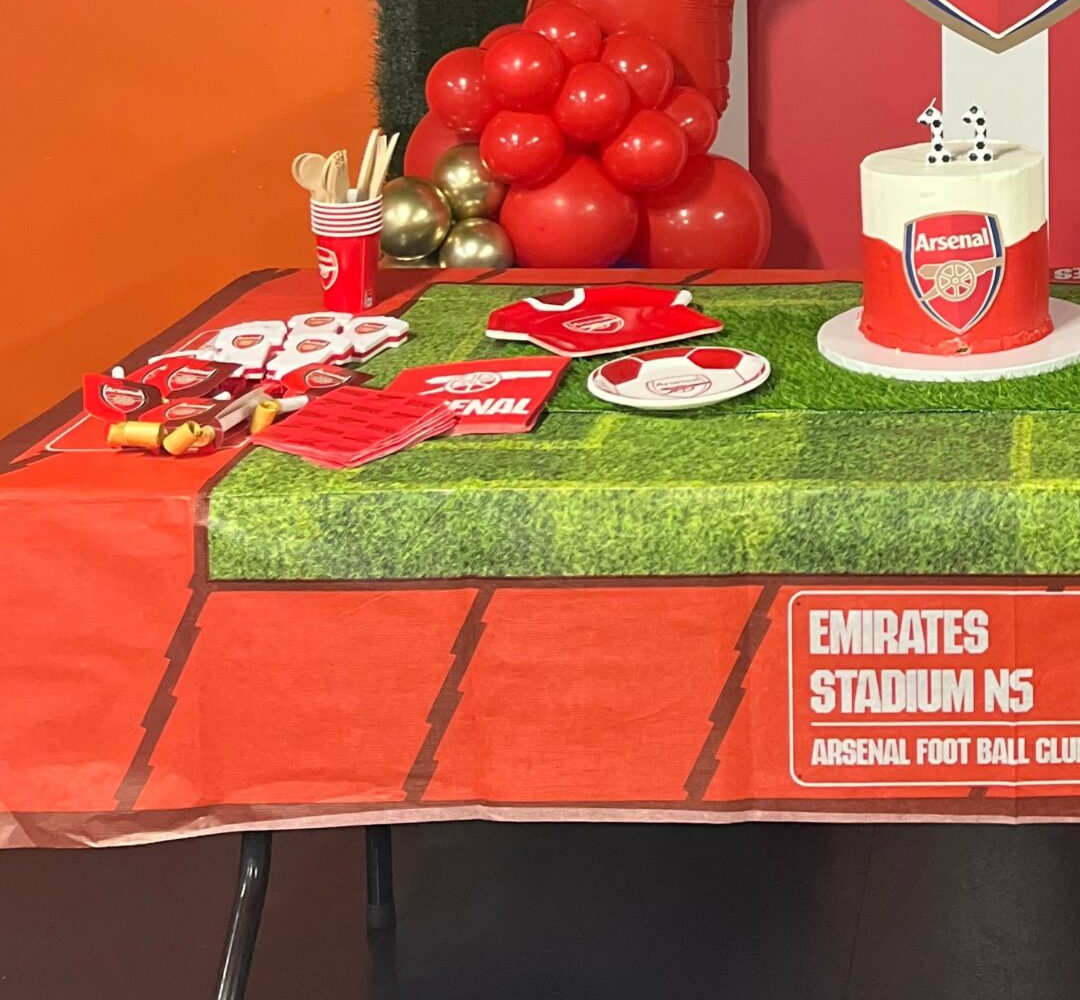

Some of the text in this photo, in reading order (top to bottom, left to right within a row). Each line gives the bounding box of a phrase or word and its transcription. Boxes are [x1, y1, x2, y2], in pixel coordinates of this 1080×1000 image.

[915, 226, 990, 252] Arsenal
[446, 398, 531, 416] ENAL
[809, 609, 989, 655] EMIRATES
[810, 669, 1034, 714] STADIUM N5
[811, 738, 911, 766] ARSENAL
[916, 738, 971, 765] FOOT
[976, 737, 1030, 766] BALL
